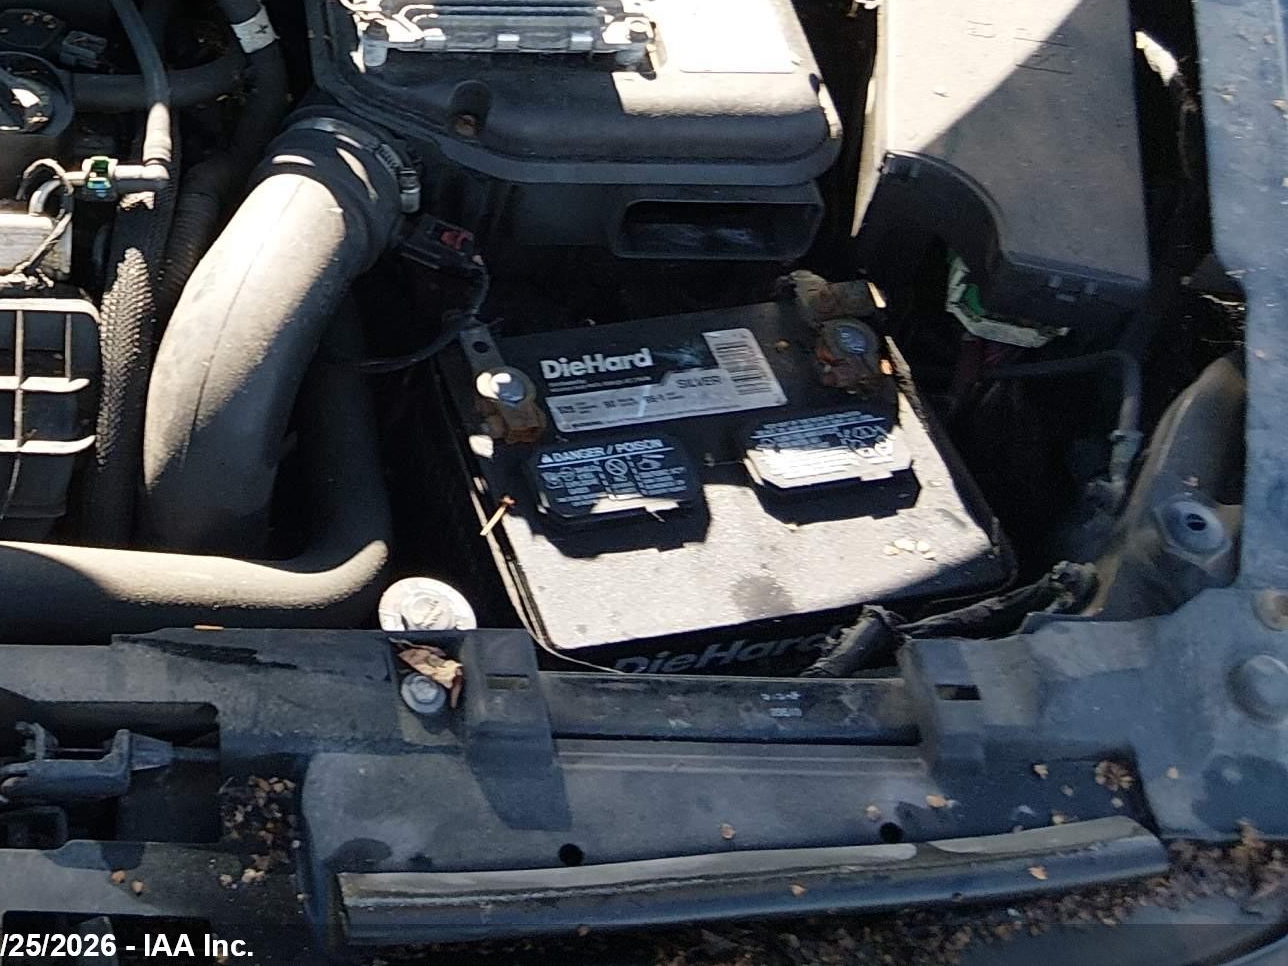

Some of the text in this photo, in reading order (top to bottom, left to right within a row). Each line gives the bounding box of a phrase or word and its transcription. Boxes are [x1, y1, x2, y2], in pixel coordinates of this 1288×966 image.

[540, 347, 655, 380] DieHard
[676, 375, 722, 389] SILVER
[552, 447, 606, 462] DANGER
[615, 438, 664, 453] POISON
